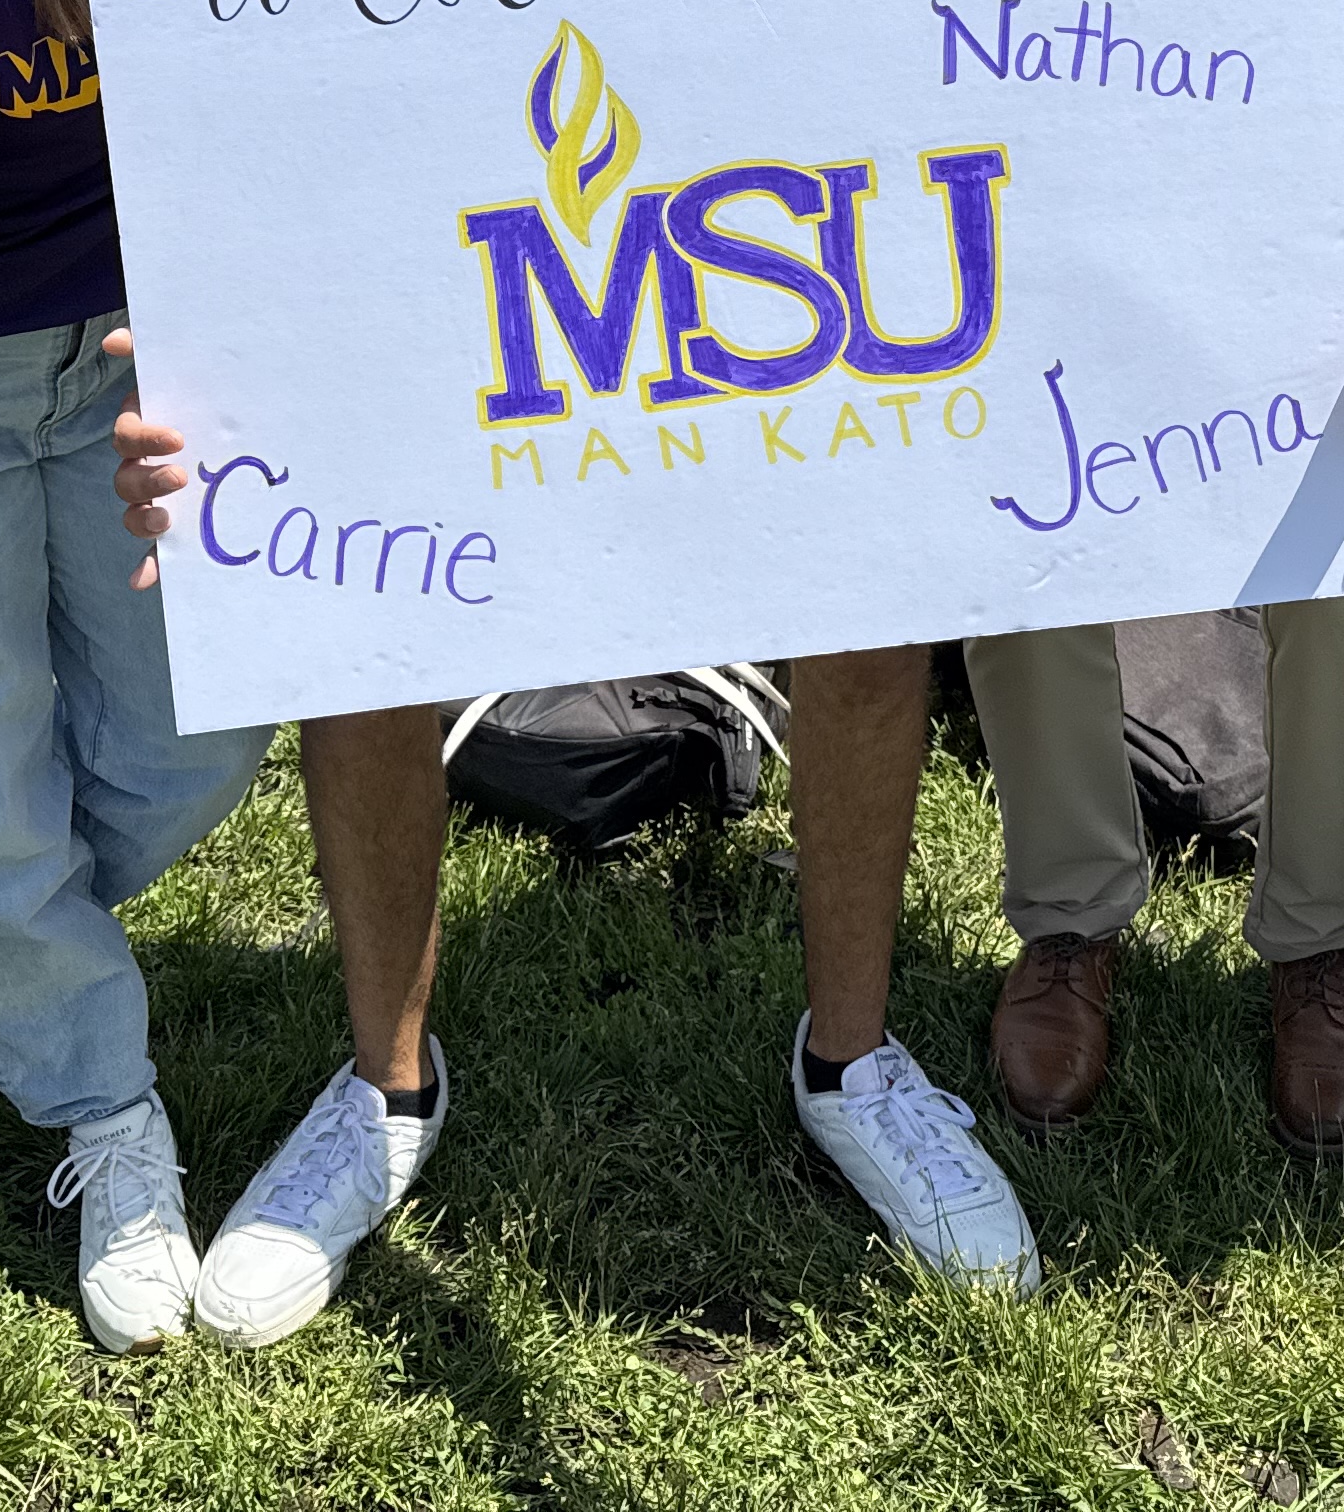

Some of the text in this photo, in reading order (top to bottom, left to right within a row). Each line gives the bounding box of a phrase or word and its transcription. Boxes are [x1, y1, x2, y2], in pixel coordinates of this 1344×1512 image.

[457, 143, 1012, 430] MSU
[990, 358, 1324, 532] Jenna
[197, 455, 497, 605] Carrie
[89, 1126, 132, 1146] SKECHERS
